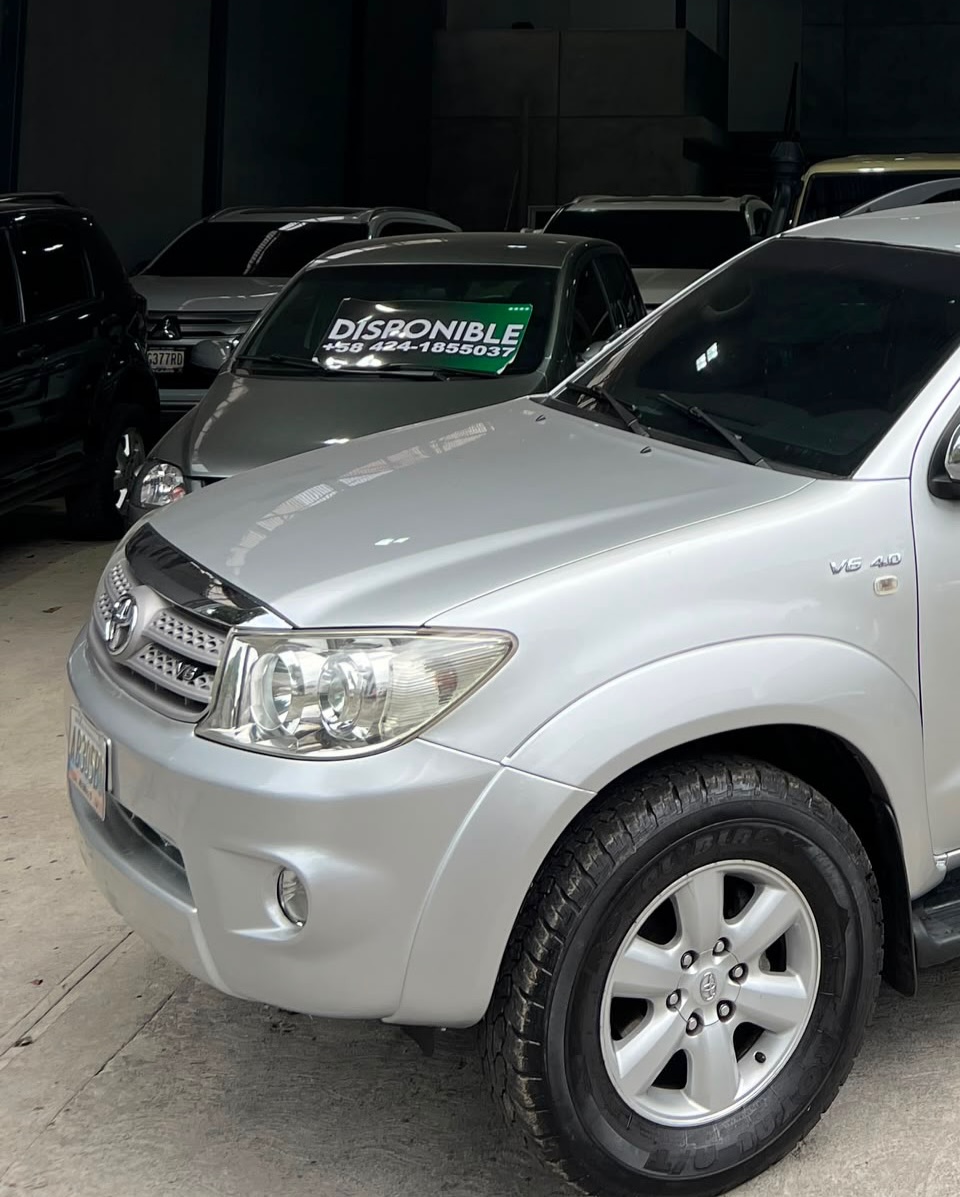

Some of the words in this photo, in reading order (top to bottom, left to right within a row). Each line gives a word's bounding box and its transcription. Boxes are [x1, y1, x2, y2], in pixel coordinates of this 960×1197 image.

[328, 318, 525, 345] DISPONIBLE
[322, 342, 364, 353] +58
[369, 340, 516, 357] 424-1855037
[829, 556, 863, 575] V6
[869, 552, 903, 569] 4.0
[176, 661, 199, 681] V6
